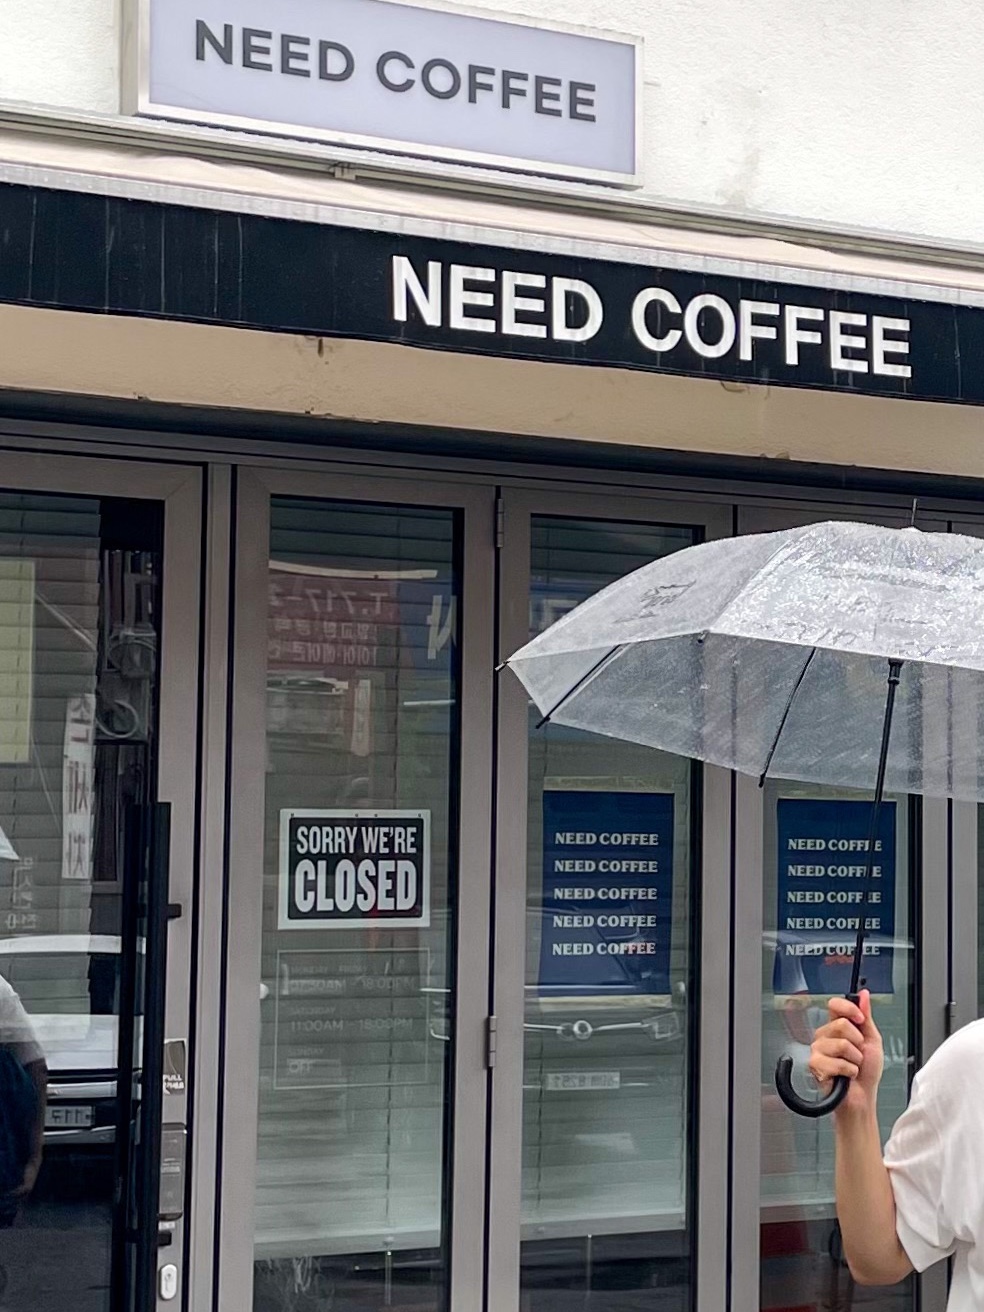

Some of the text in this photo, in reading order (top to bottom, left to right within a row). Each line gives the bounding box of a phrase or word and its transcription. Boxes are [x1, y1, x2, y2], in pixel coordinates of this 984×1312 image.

[195, 19, 597, 123] NEED COFFEE
[391, 255, 912, 378] NEED COFFEE
[296, 826, 418, 854] SORRY WE'RE
[555, 832, 659, 846] NEED COFFEE
[787, 838, 826, 851] NEED
[554, 860, 658, 873] NEED COFFEE
[787, 865, 882, 877] NEED COFFE
[294, 859, 418, 913] CLOSED
[553, 888, 658, 900] NEED COFFEE
[787, 891, 825, 903] NEED
[553, 915, 657, 928] NEED COFFEE
[786, 918, 824, 930] NEED
[552, 942, 656, 956] NEED COFFEE
[785, 944, 880, 956] NEED COFEE
[290, 1019, 344, 1032] 11:00AM
